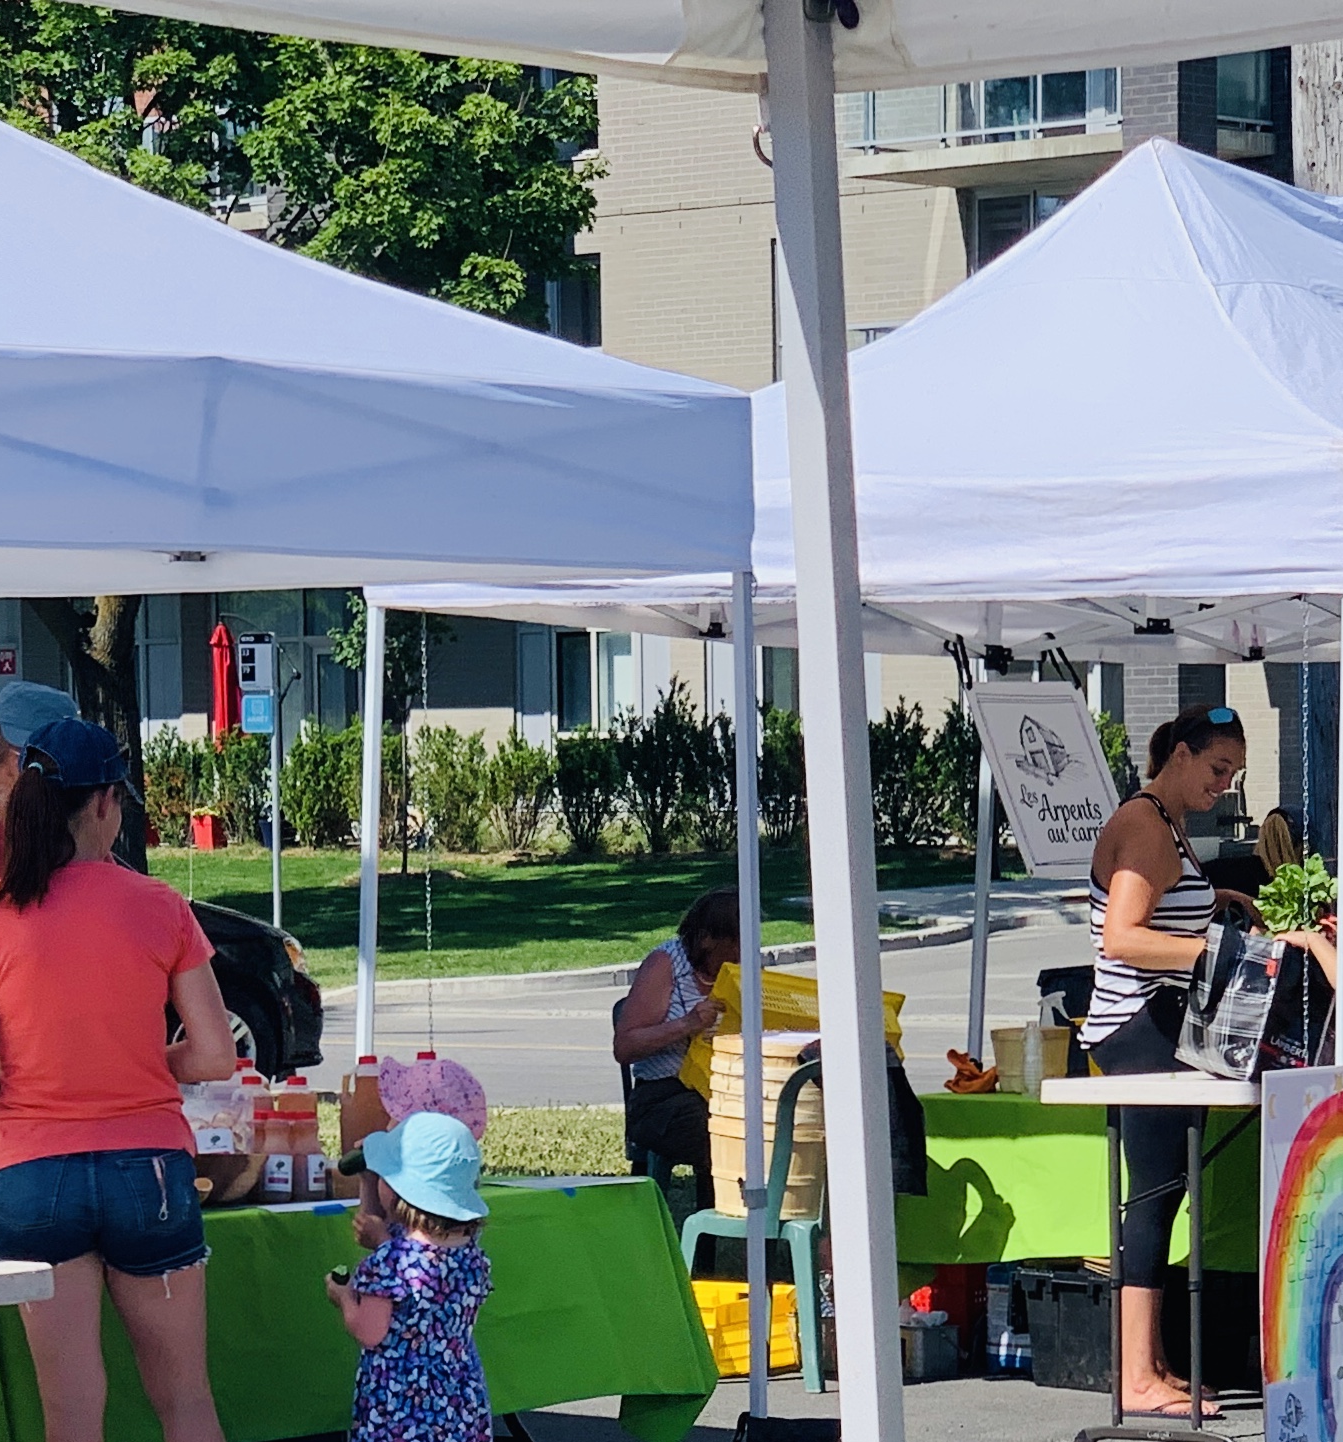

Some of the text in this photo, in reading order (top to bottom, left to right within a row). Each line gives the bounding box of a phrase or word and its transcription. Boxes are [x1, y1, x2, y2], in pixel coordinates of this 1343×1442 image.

[1019, 783, 1039, 809] Les
[1037, 793, 1103, 831] Arpents
[1047, 826, 1069, 844] au
